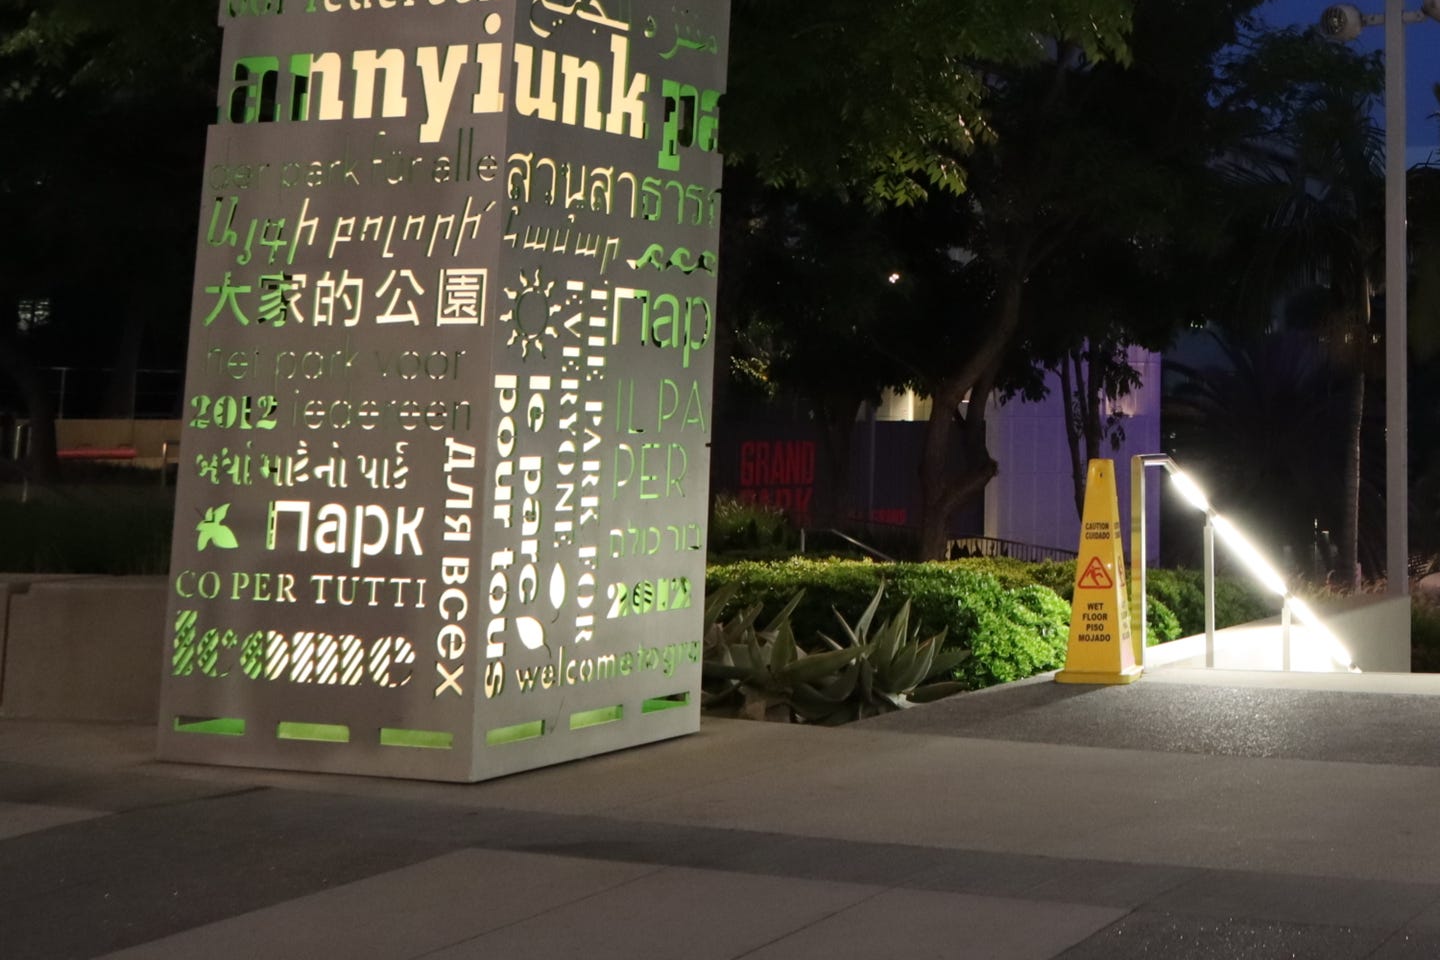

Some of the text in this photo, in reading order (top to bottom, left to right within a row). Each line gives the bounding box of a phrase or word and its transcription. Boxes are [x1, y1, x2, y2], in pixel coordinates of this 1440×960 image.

[432, 127, 499, 184] alle
[202, 267, 488, 328] 大家的公園
[189, 394, 279, 431] 2012
[615, 377, 645, 434] IL
[581, 400, 604, 526] PARK
[612, 442, 689, 500] PER
[740, 441, 817, 486] GRAND
[518, 374, 552, 605] le parc
[265, 499, 426, 569] Парк
[484, 374, 520, 700] pour tous
[1085, 522, 1110, 531] CAUTION
[1085, 531, 1111, 540] CUIDADO
[230, 571, 298, 604] PER
[310, 574, 428, 609] TUTTI
[606, 575, 692, 620] 2012
[1087, 602, 1105, 611] WET
[1078, 633, 1111, 642] MOJADO
[1082, 613, 1108, 622] FLOOR
[1086, 623, 1105, 632] PISO
[515, 646, 634, 693] welcome
[636, 643, 660, 673] to
